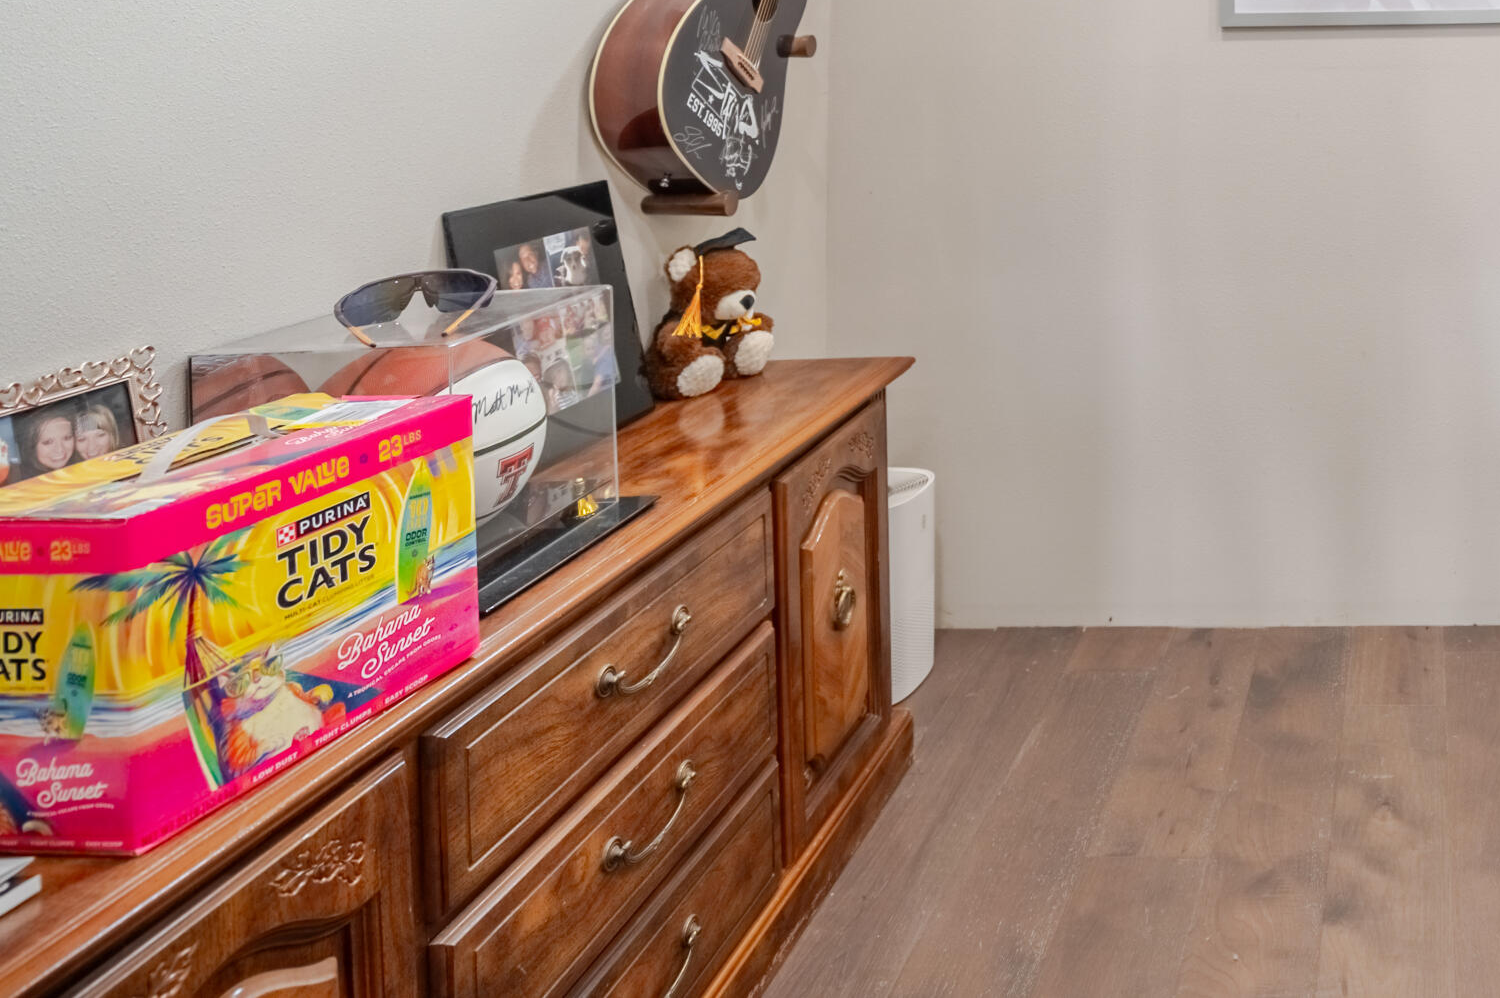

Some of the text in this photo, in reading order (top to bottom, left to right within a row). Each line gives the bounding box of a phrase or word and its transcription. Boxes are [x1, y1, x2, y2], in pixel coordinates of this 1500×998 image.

[702, 108, 724, 137] 1995
[378, 434, 403, 464] 23
[403, 430, 422, 448] LBS
[299, 494, 368, 535] PURINA
[405, 528, 428, 542] ODOR
[51, 540, 72, 561] 23
[72, 542, 90, 554] LBS
[277, 515, 371, 577] TIDY
[277, 544, 376, 609] CATS
[337, 604, 421, 671] Bahama
[361, 617, 436, 679] Sunset
[353, 674, 383, 696] TROPICAL
[383, 657, 406, 676] ESCAPE
[406, 645, 422, 658] FROM
[252, 674, 429, 783] LOW DUST TIGHT CLUMPS EASY SCOOP
[16, 757, 94, 787] Bahama
[37, 781, 109, 809] Sunset
